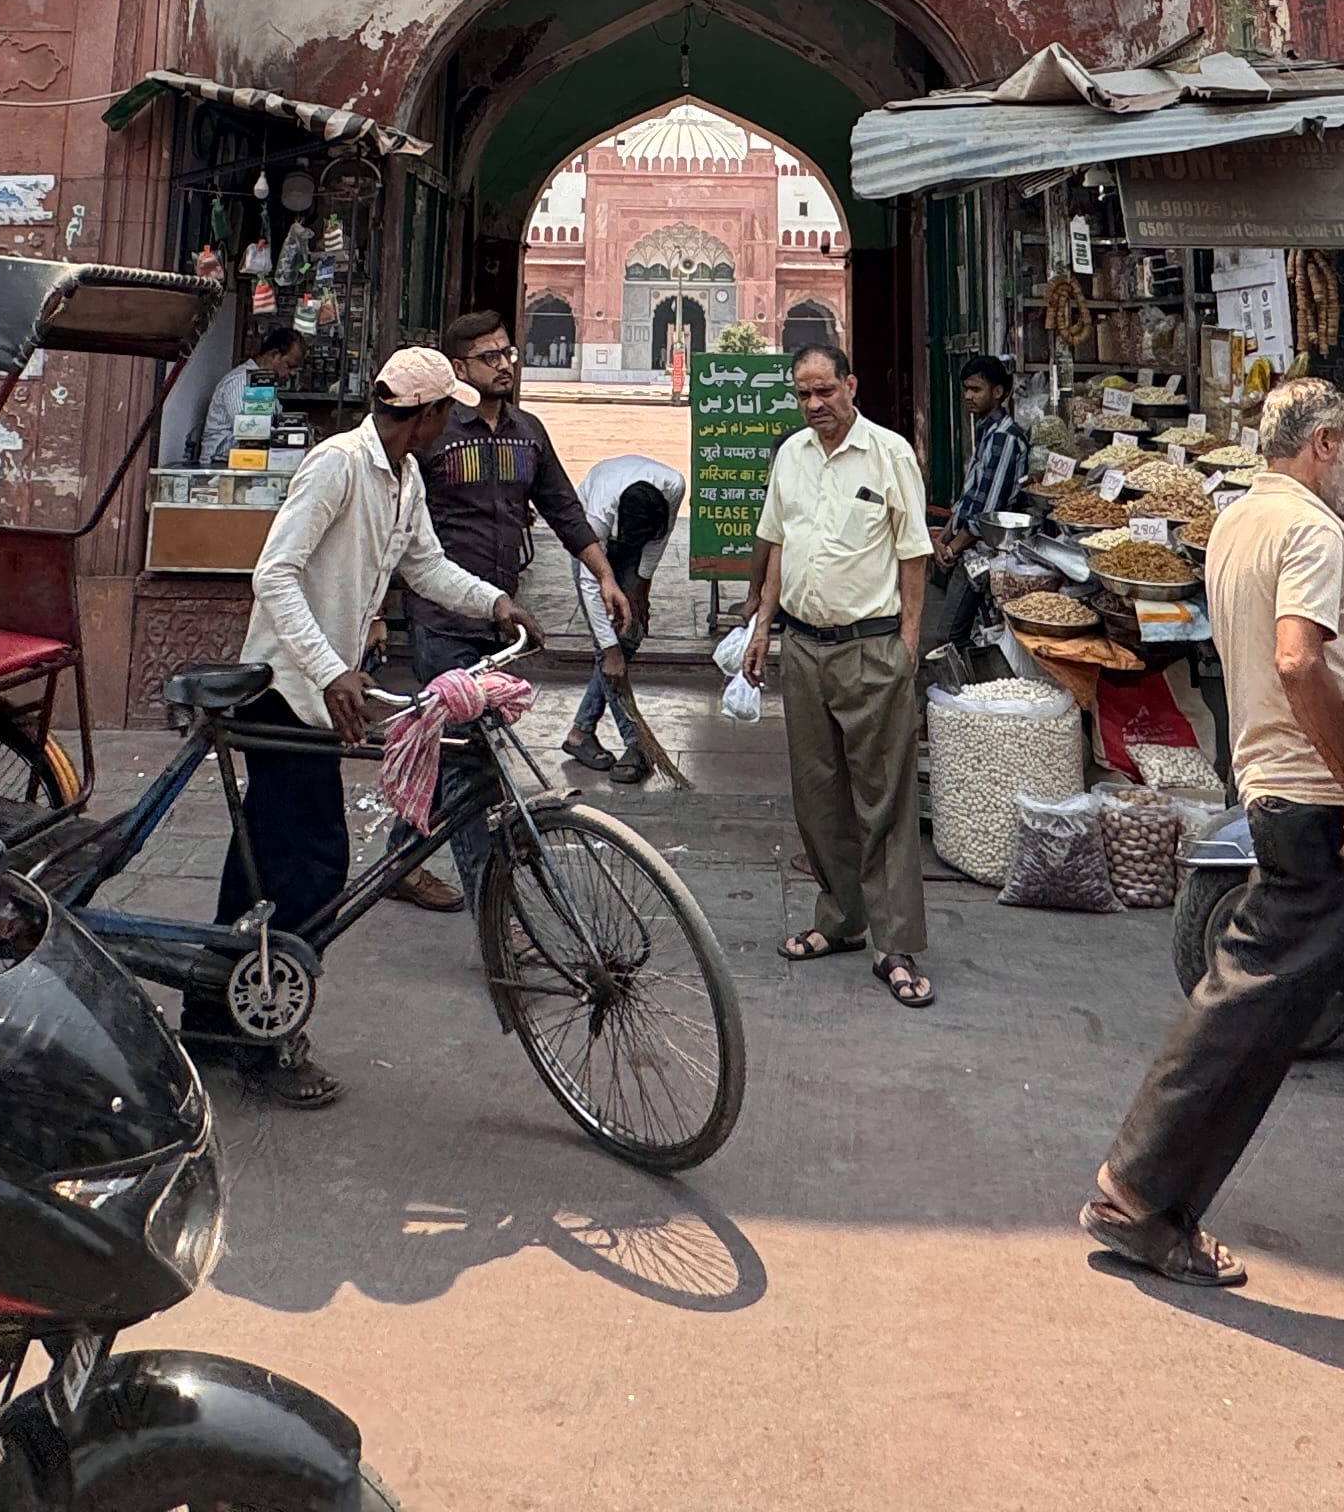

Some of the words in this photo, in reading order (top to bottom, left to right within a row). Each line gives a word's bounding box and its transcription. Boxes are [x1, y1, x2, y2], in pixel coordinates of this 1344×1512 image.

[699, 442, 721, 462] जूते
[699, 487, 718, 501] यह
[719, 488, 746, 501] आम
[698, 505, 749, 520] PLEASE
[715, 523, 752, 537] YOUR
